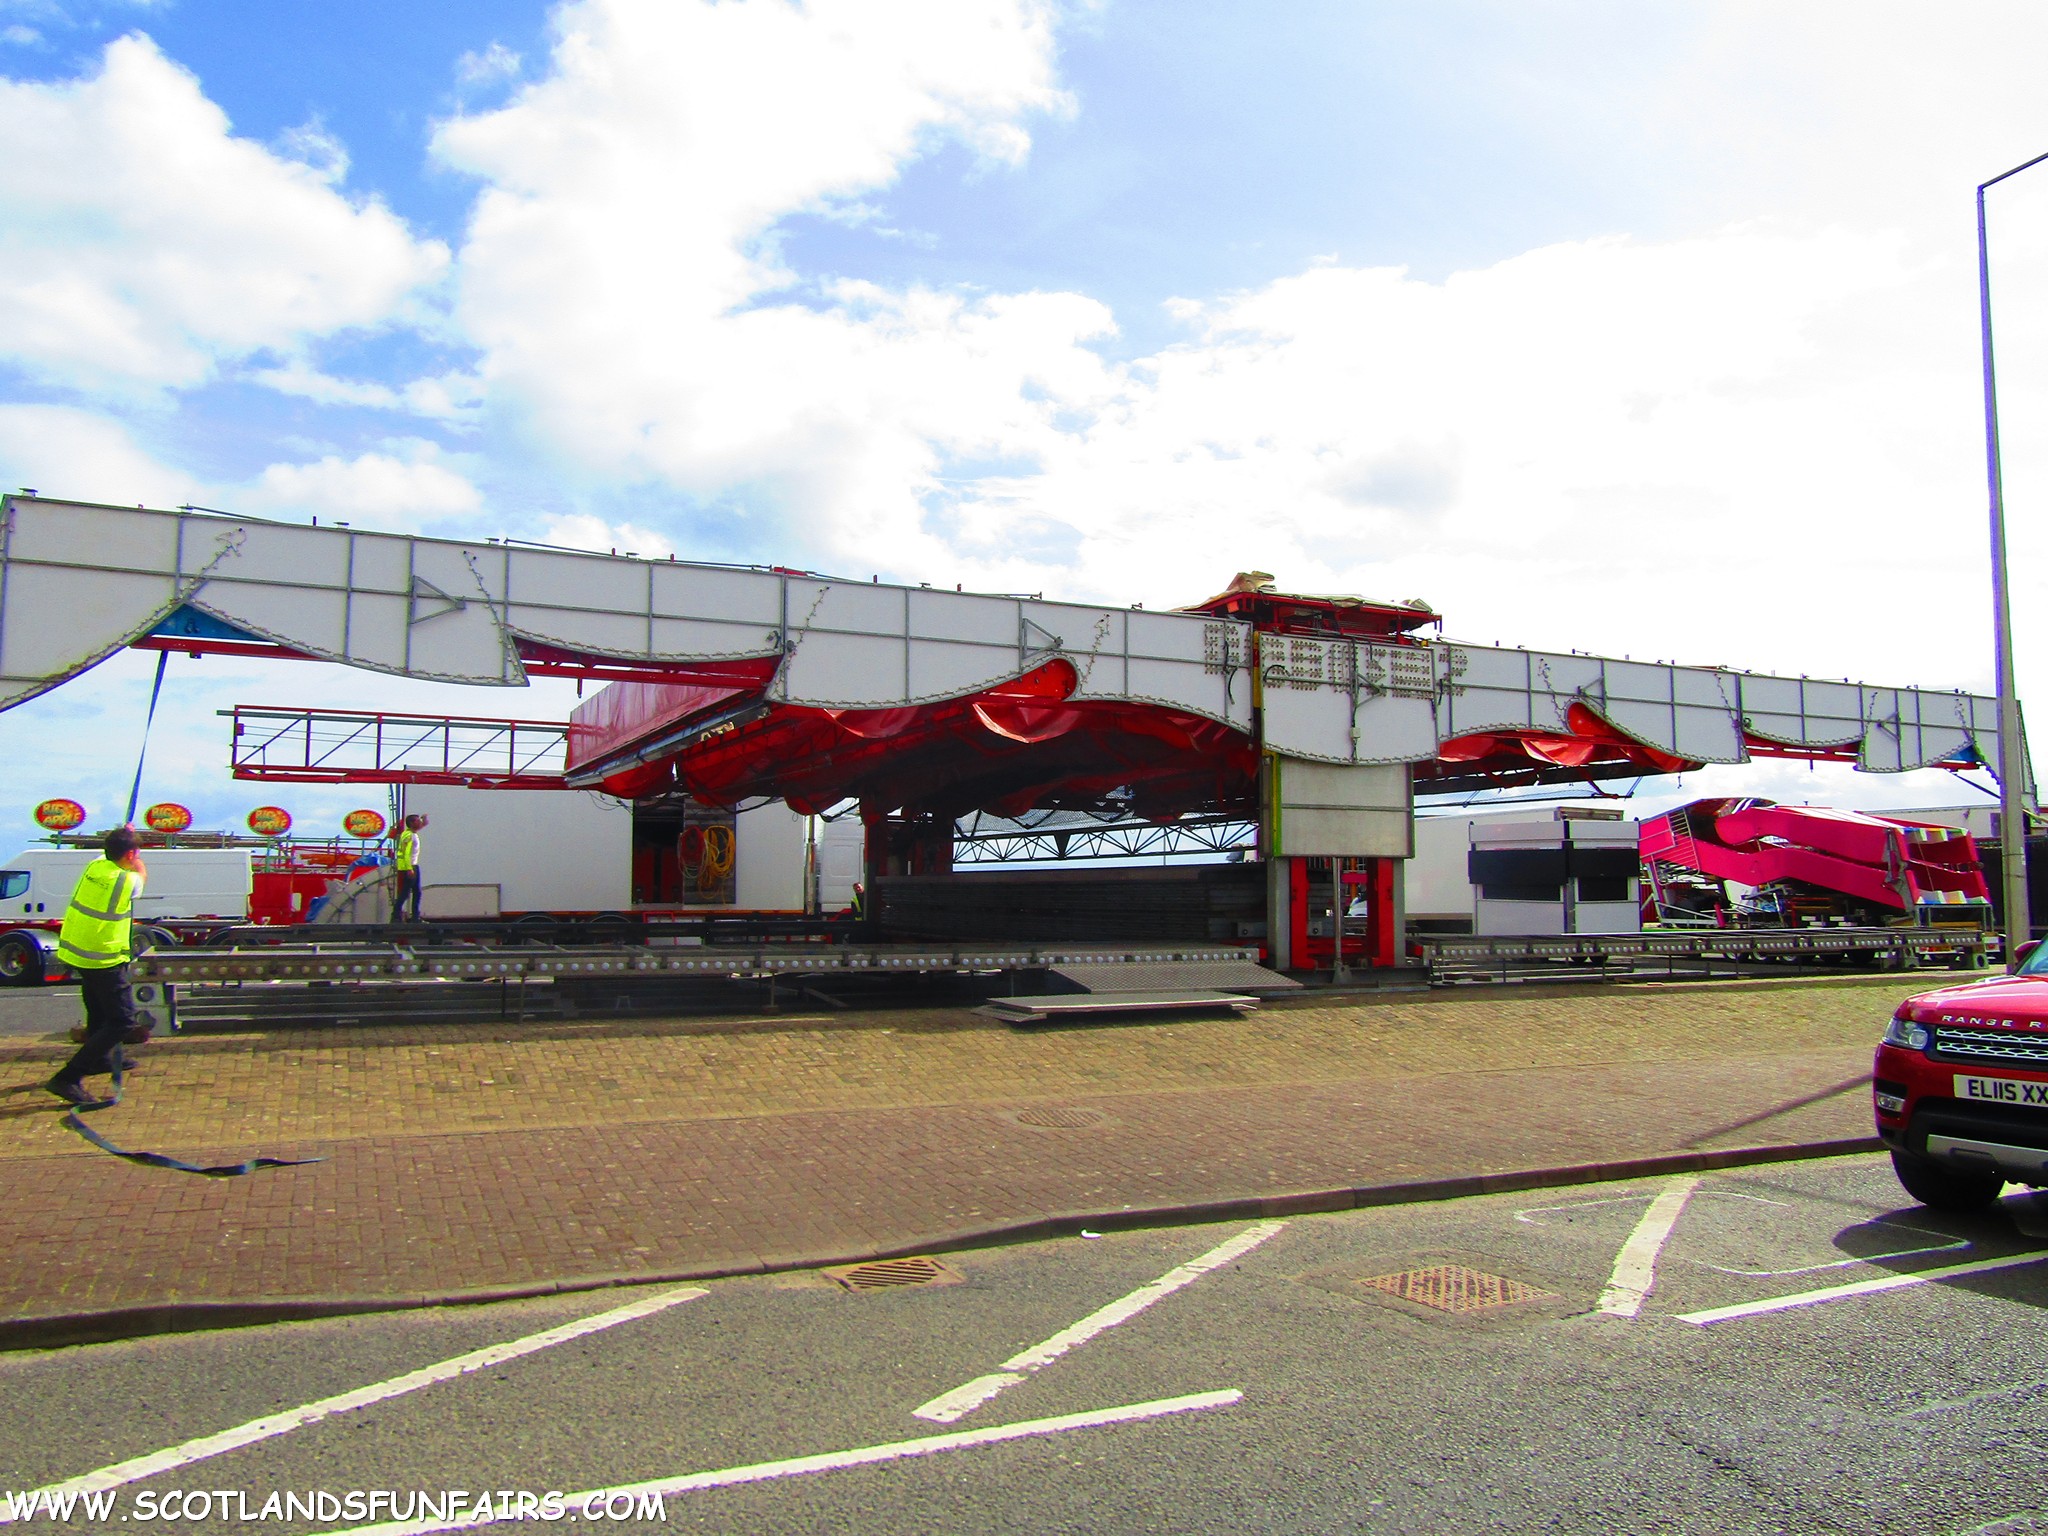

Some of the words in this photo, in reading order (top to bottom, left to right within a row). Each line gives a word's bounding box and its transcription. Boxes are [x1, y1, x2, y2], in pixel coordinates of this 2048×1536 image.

[43, 812, 81, 825] APPLE
[152, 815, 189, 828] APPLE
[256, 819, 288, 831] APPLE
[350, 822, 382, 834] APPLE
[1942, 1015, 2013, 1027] RANGE
